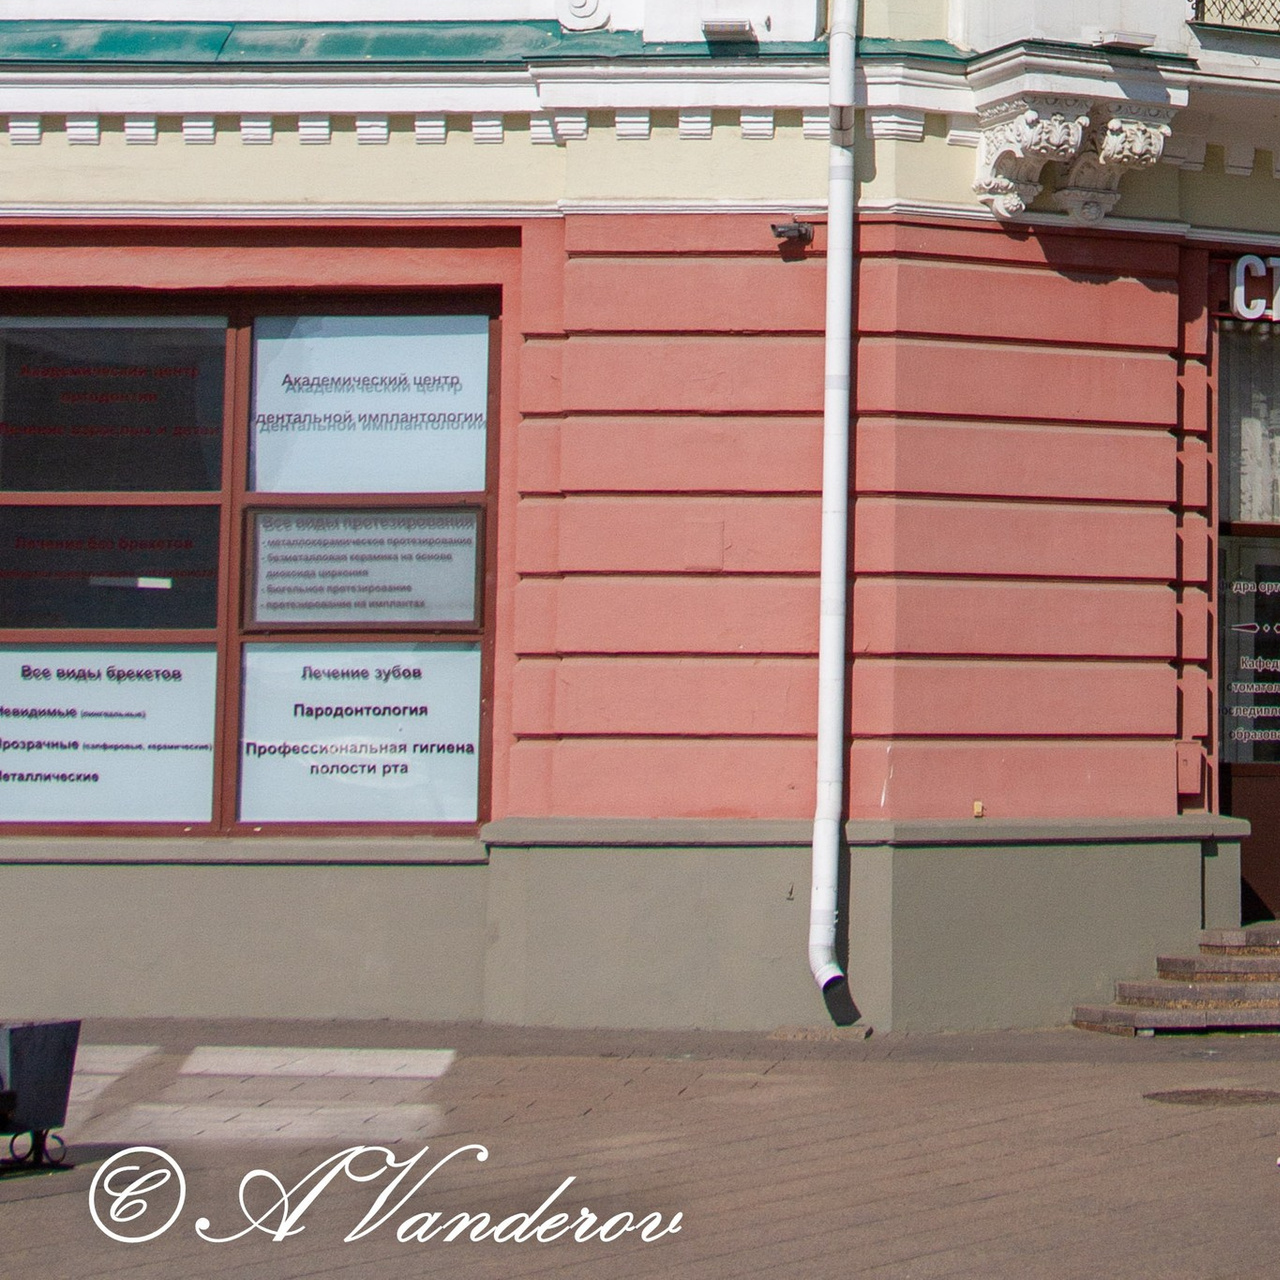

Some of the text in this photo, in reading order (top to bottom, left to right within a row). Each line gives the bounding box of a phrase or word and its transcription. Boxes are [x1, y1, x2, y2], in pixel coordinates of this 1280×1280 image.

[281, 371, 460, 389] Академический центр
[256, 410, 484, 425] дентальной имплантологии
[262, 515, 475, 532] Все виды протезирования
[20, 664, 183, 683] Все виды брекетов
[301, 665, 423, 682] Лечение зубов
[293, 703, 429, 719] Пародонтология
[245, 742, 475, 758] Профессиональная гигиена
[309, 763, 409, 778] полости рта
